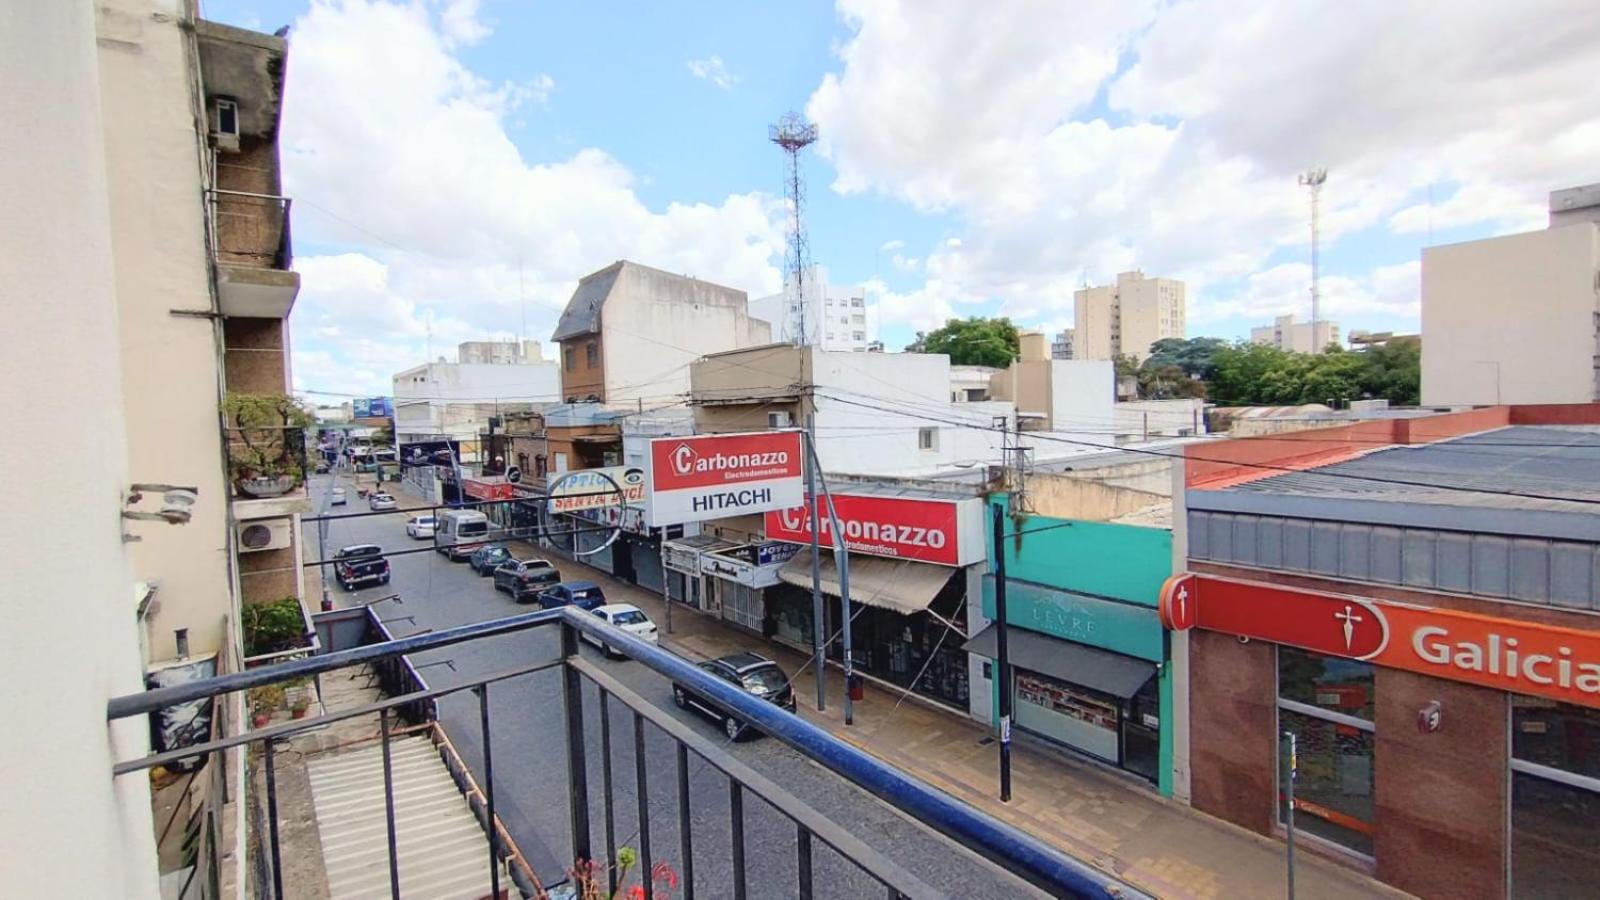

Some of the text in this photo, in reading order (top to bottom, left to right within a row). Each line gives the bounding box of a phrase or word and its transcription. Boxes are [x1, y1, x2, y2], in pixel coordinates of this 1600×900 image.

[675, 446, 788, 473] Carbonazzo
[692, 488, 772, 512] HITACHI
[1033, 608, 1096, 632] LEVRE
[1412, 626, 1600, 693] Galicia
